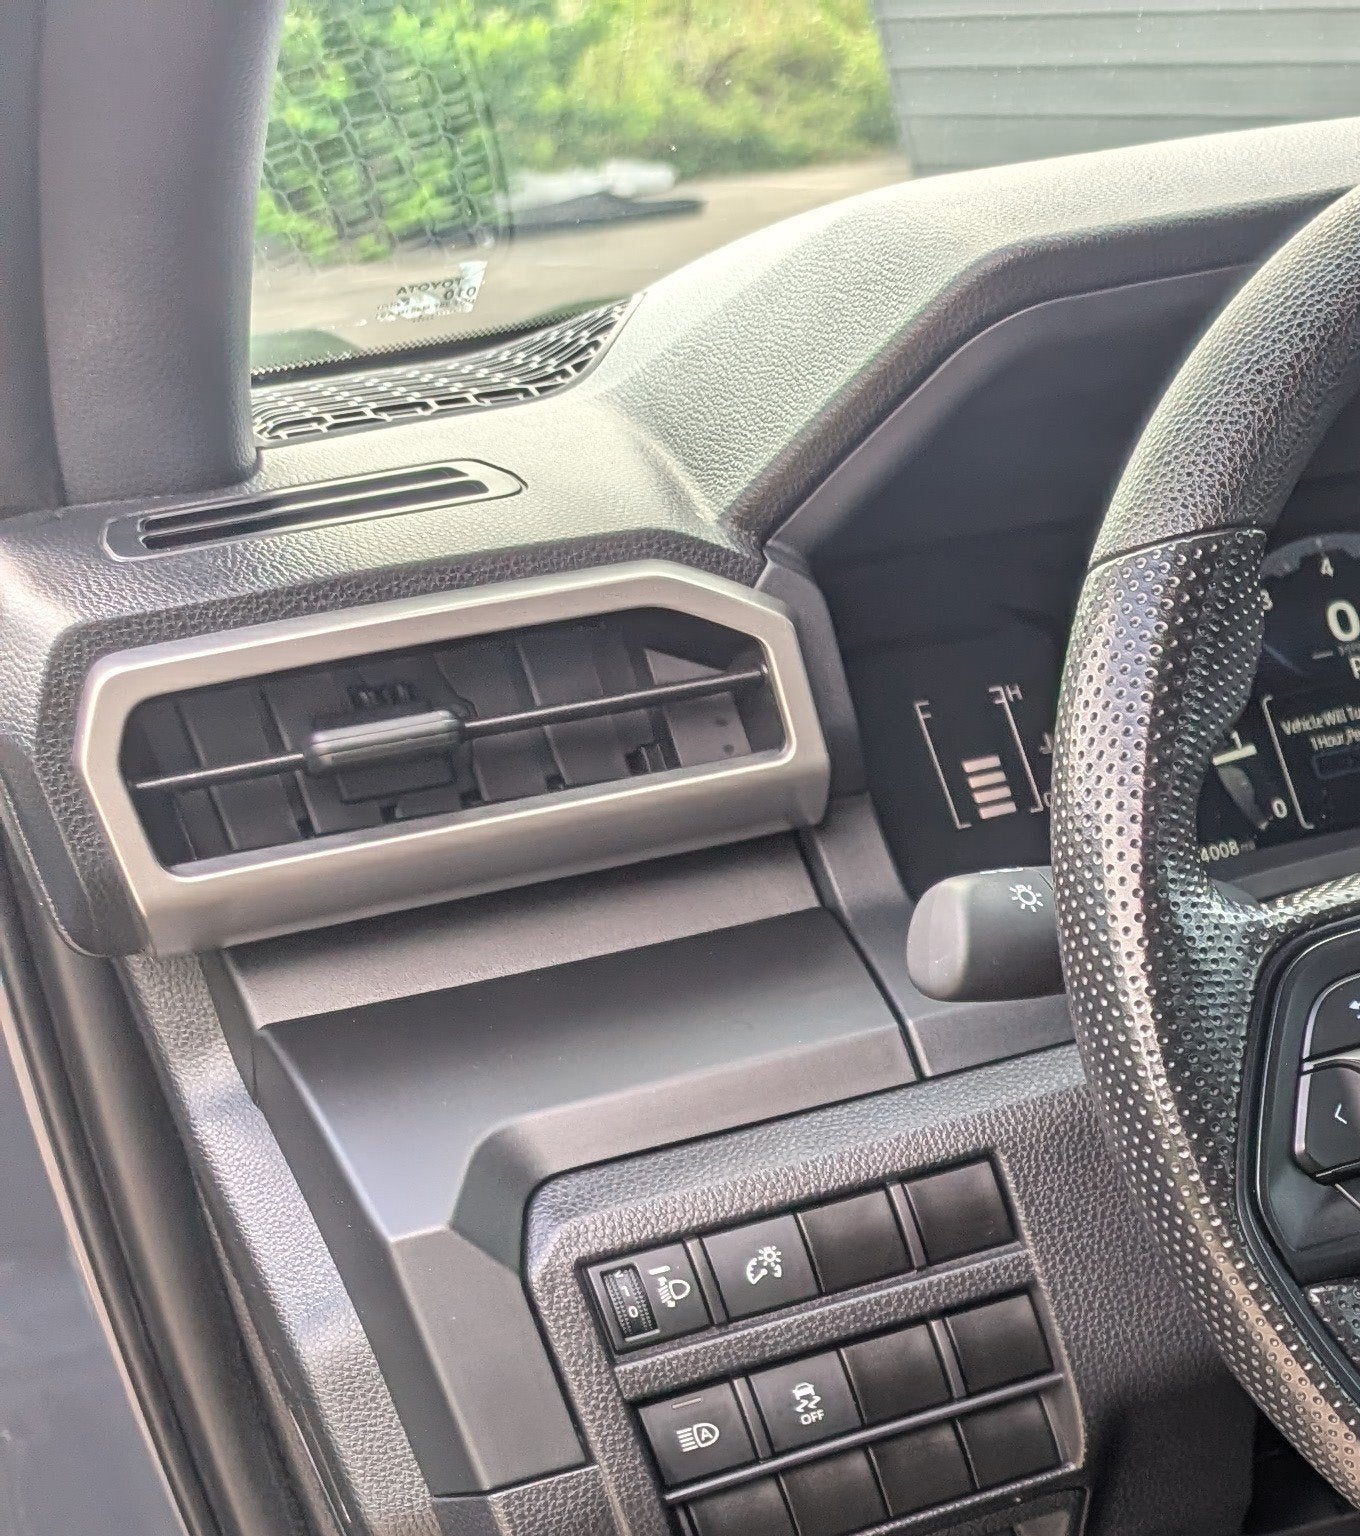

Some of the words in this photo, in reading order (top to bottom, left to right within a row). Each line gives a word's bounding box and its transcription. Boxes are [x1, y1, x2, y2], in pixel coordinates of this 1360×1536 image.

[1319, 556, 1335, 578] 4
[1326, 600, 1360, 642] 0
[1005, 684, 1024, 703] H
[1280, 714, 1325, 736] Vehicle
[1323, 707, 1348, 726] Will
[1271, 797, 1289, 819] 0
[1200, 839, 1240, 863] 4008
[628, 1305, 639, 1318] 0
[800, 1409, 825, 1425] OFF
